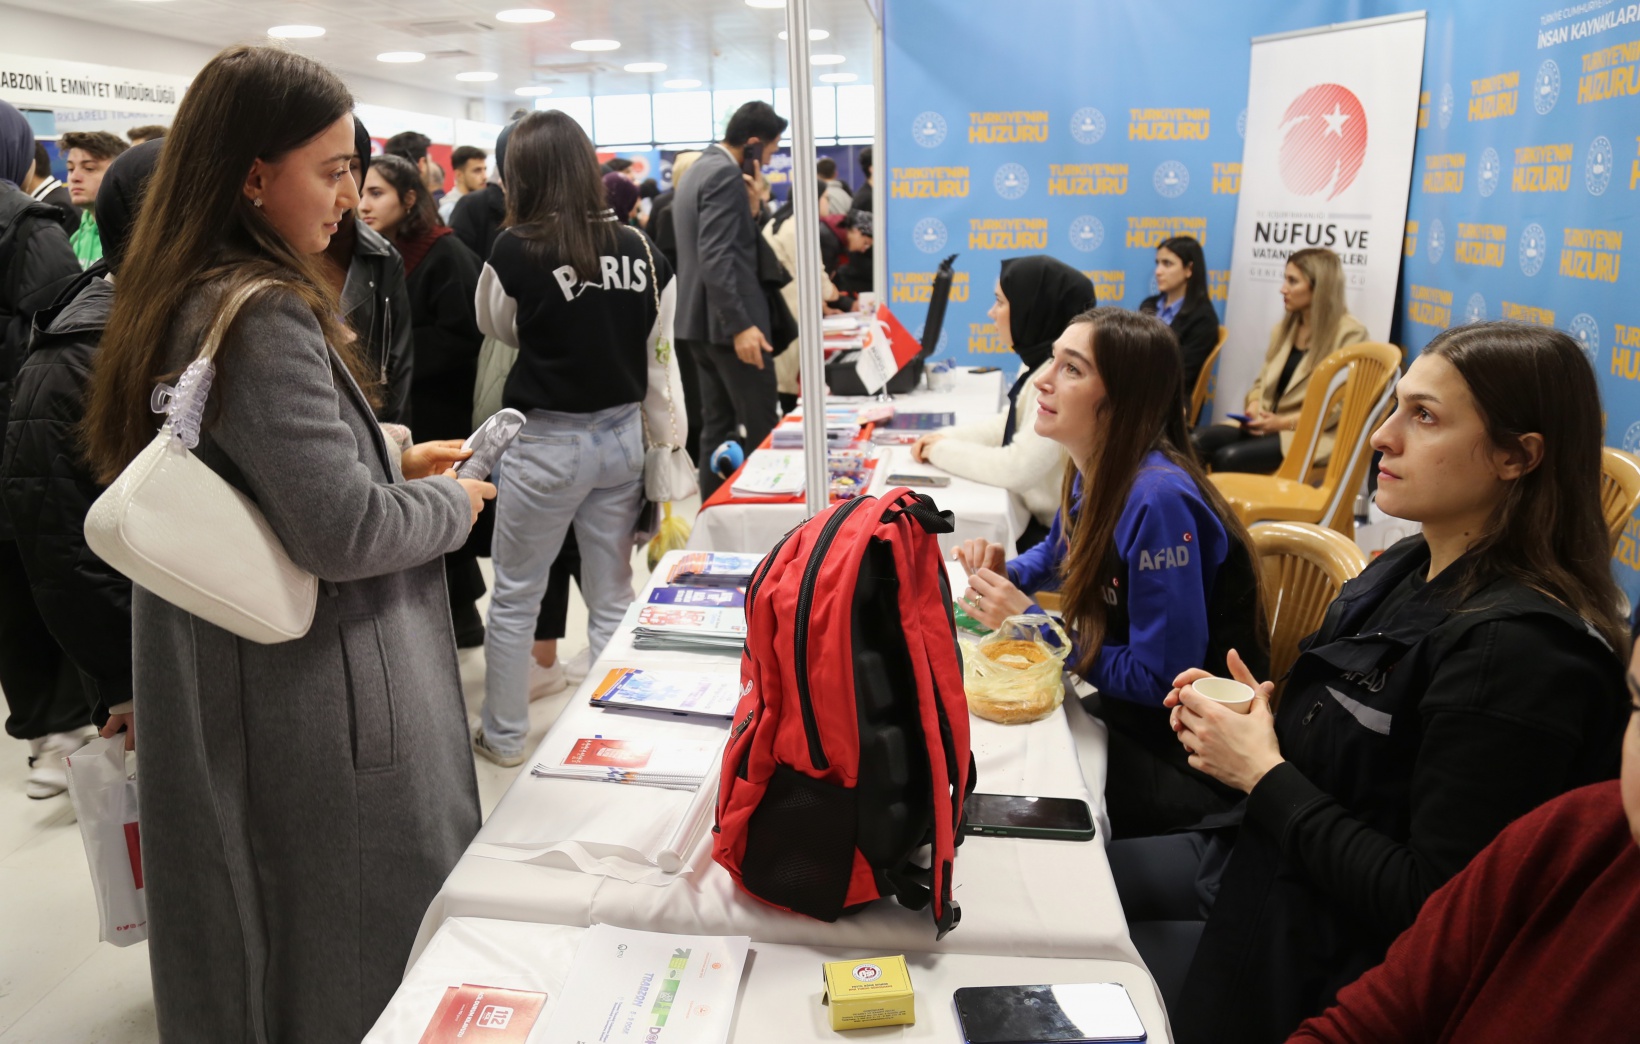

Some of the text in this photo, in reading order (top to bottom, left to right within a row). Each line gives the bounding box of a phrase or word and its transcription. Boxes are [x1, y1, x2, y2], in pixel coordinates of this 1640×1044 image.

[1537, 26, 1568, 49] İNSAN
[46, 71, 57, 92] İL
[61, 75, 109, 98] EMNİYET
[1577, 65, 1640, 104] HUZURU
[1468, 90, 1518, 121] HUZURU
[969, 125, 1048, 143] HUZURU
[1128, 122, 1209, 140] HUZURU
[891, 181, 969, 198] HUZURU
[1049, 178, 1127, 195] HUZURU
[1422, 171, 1464, 193] HUZURU
[1511, 163, 1571, 191] HUZURU
[969, 232, 1047, 249] HUZURU
[1254, 222, 1369, 249] NÜFUS VE
[1456, 240, 1505, 268] HUZURU
[1560, 249, 1620, 282] HUZURU
[552, 256, 648, 302] PRIS
[1139, 545, 1189, 571] AFAD
[491, 1009, 508, 1025] 112
